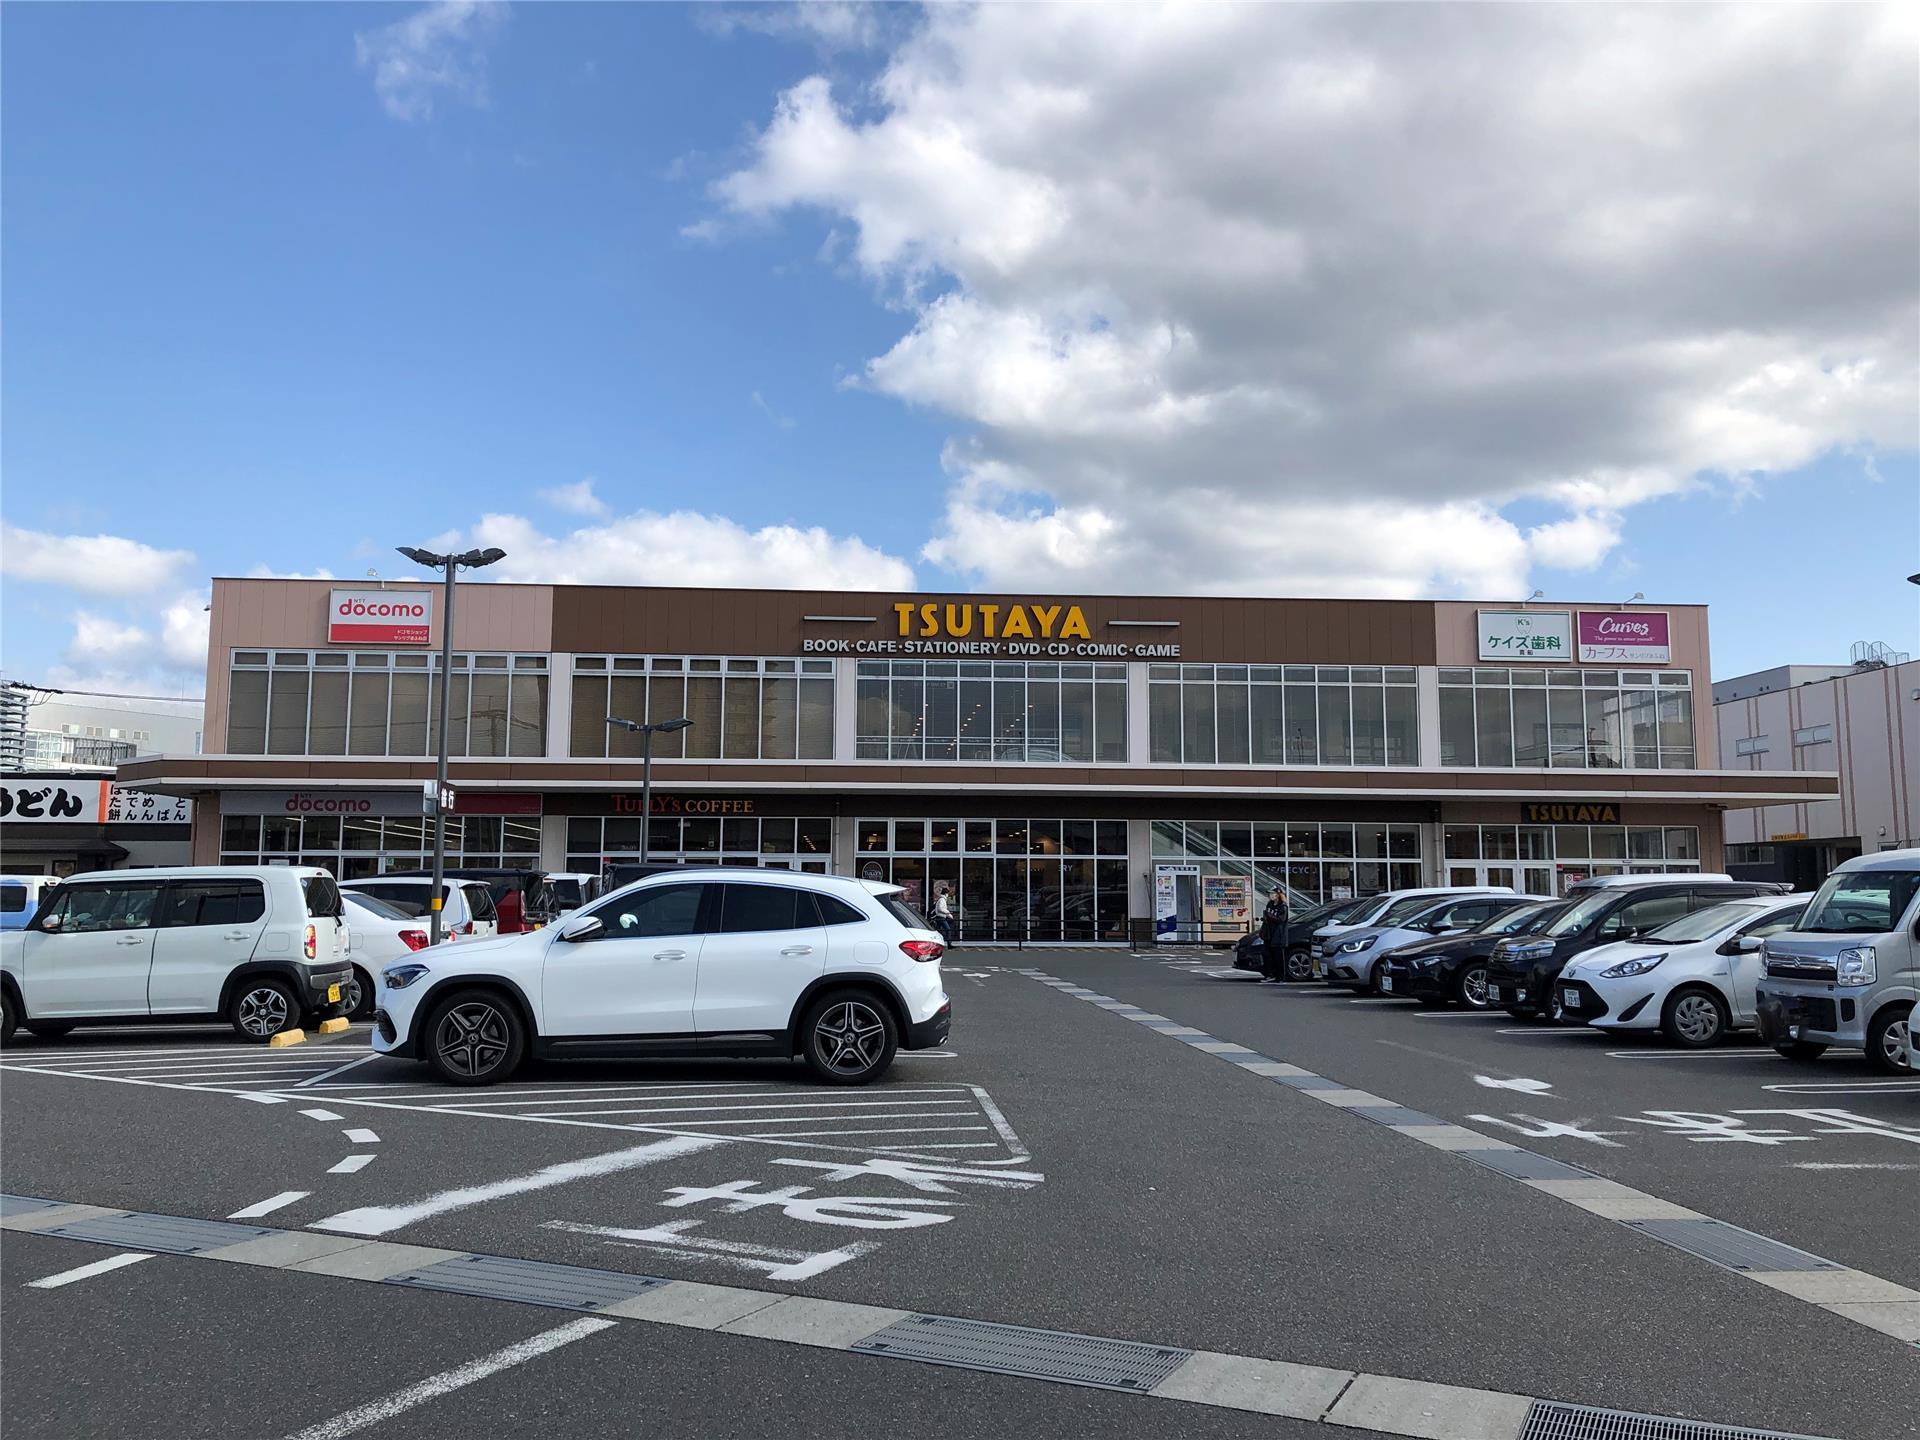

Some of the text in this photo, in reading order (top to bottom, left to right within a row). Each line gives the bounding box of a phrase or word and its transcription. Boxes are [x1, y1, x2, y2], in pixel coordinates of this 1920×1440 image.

[339, 598, 424, 617] docomo
[893, 602, 1091, 640] TSUTAYA
[1517, 618, 1530, 626] K's
[1598, 617, 1650, 636] Curves
[1487, 635, 1562, 650] ケイズ歯科
[1585, 646, 1628, 659] カーブス
[285, 793, 371, 812] docomo
[685, 799, 754, 813] COFFEE
[1528, 804, 1616, 823] TSUTAYA
